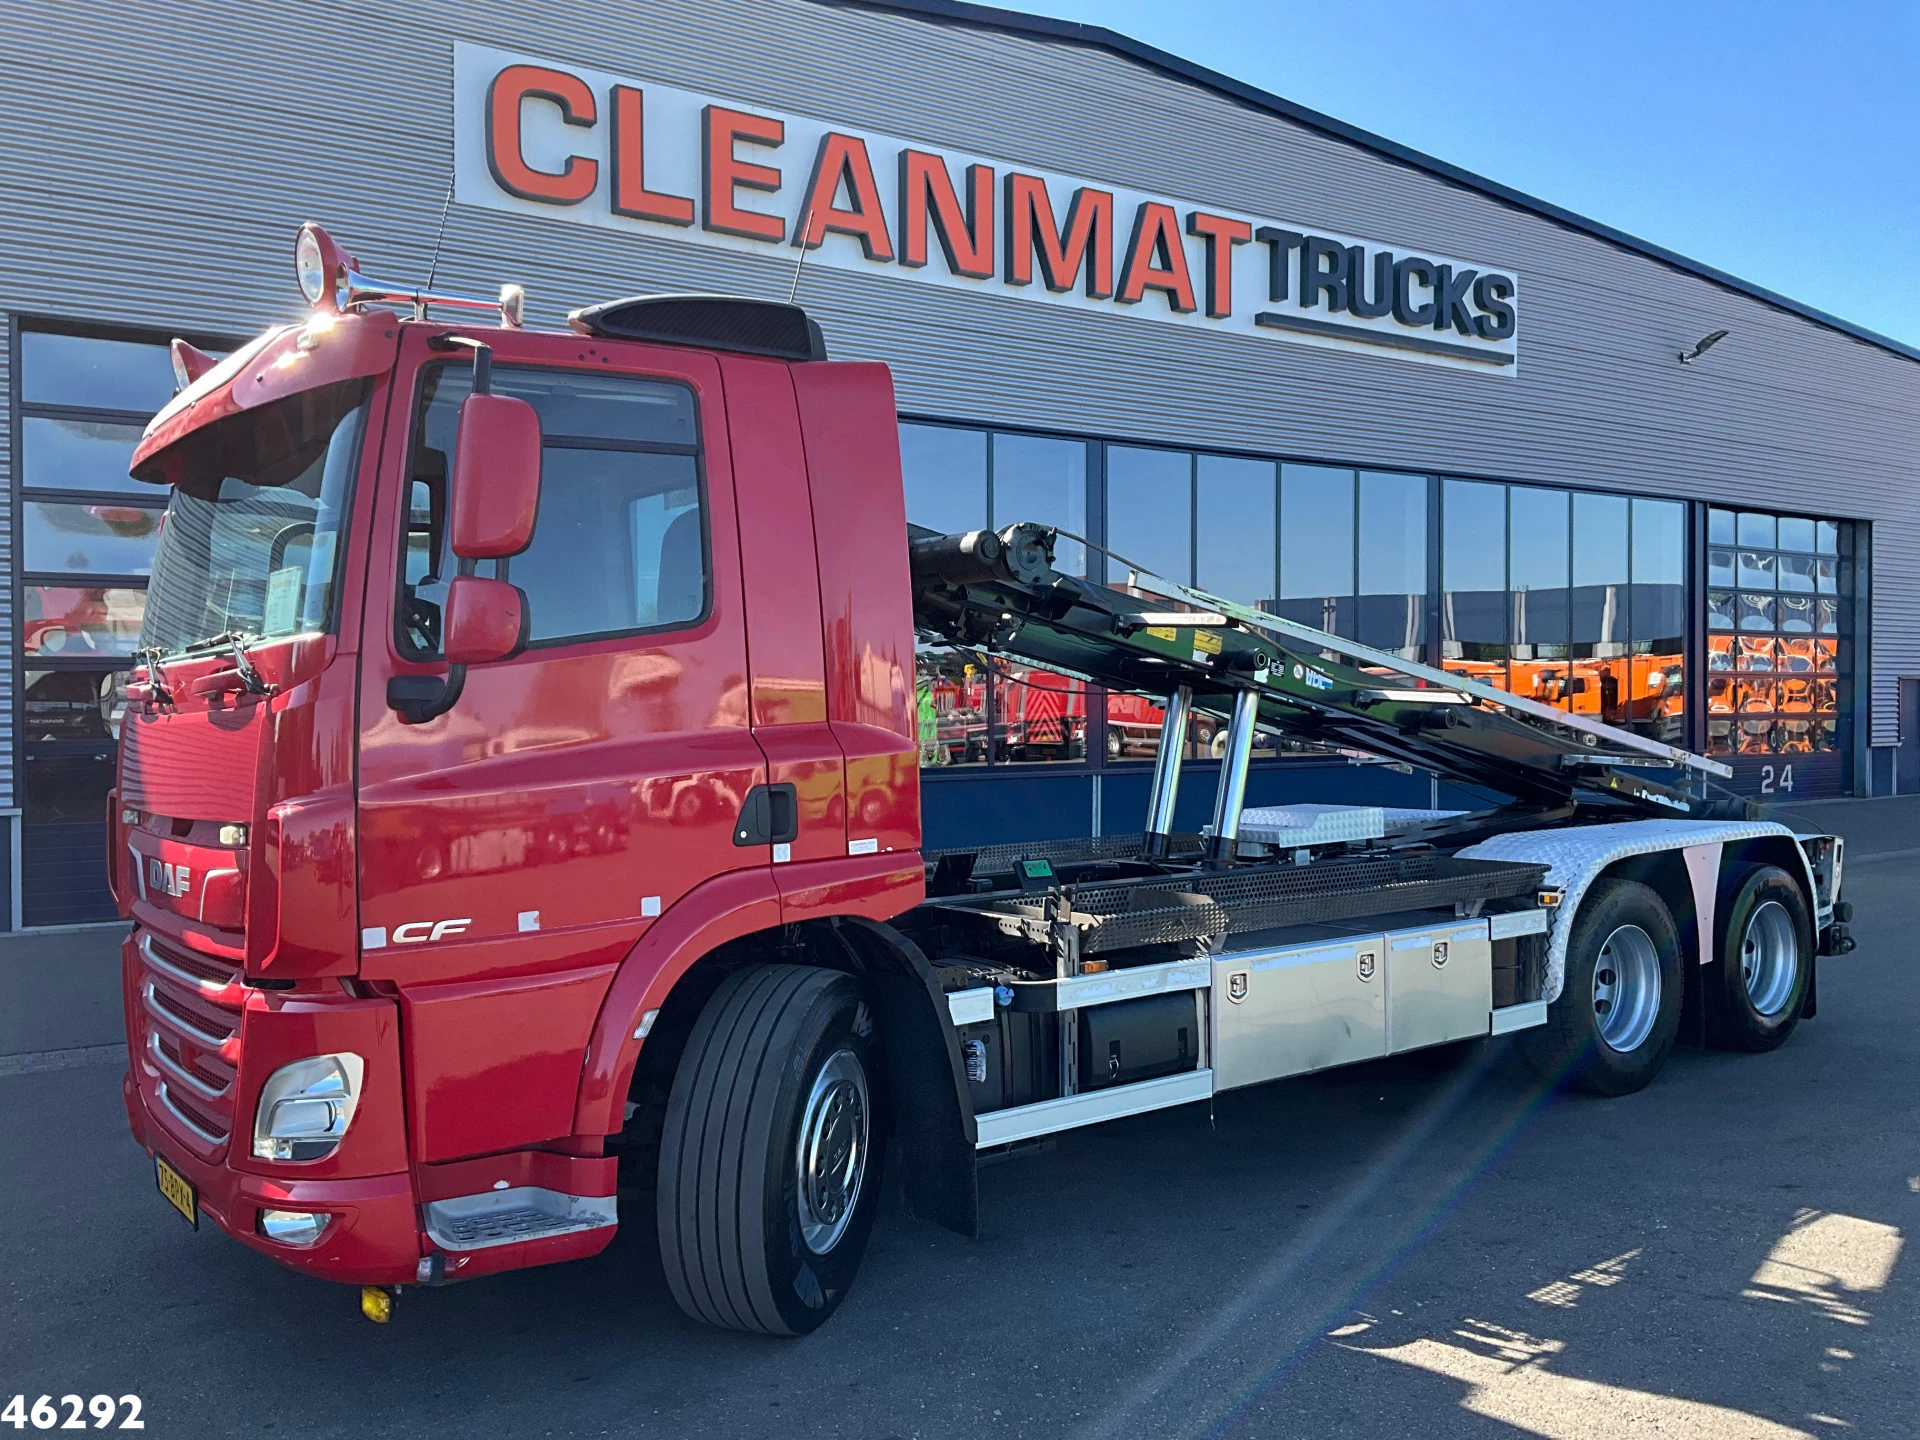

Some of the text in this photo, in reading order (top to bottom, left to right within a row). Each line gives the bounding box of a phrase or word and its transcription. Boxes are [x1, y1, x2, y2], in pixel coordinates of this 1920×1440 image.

[484, 63, 1516, 341] CLEANMAT TRUCKS
[1761, 764, 1794, 794] 24
[150, 857, 191, 898] DAF
[392, 918, 472, 943] CF
